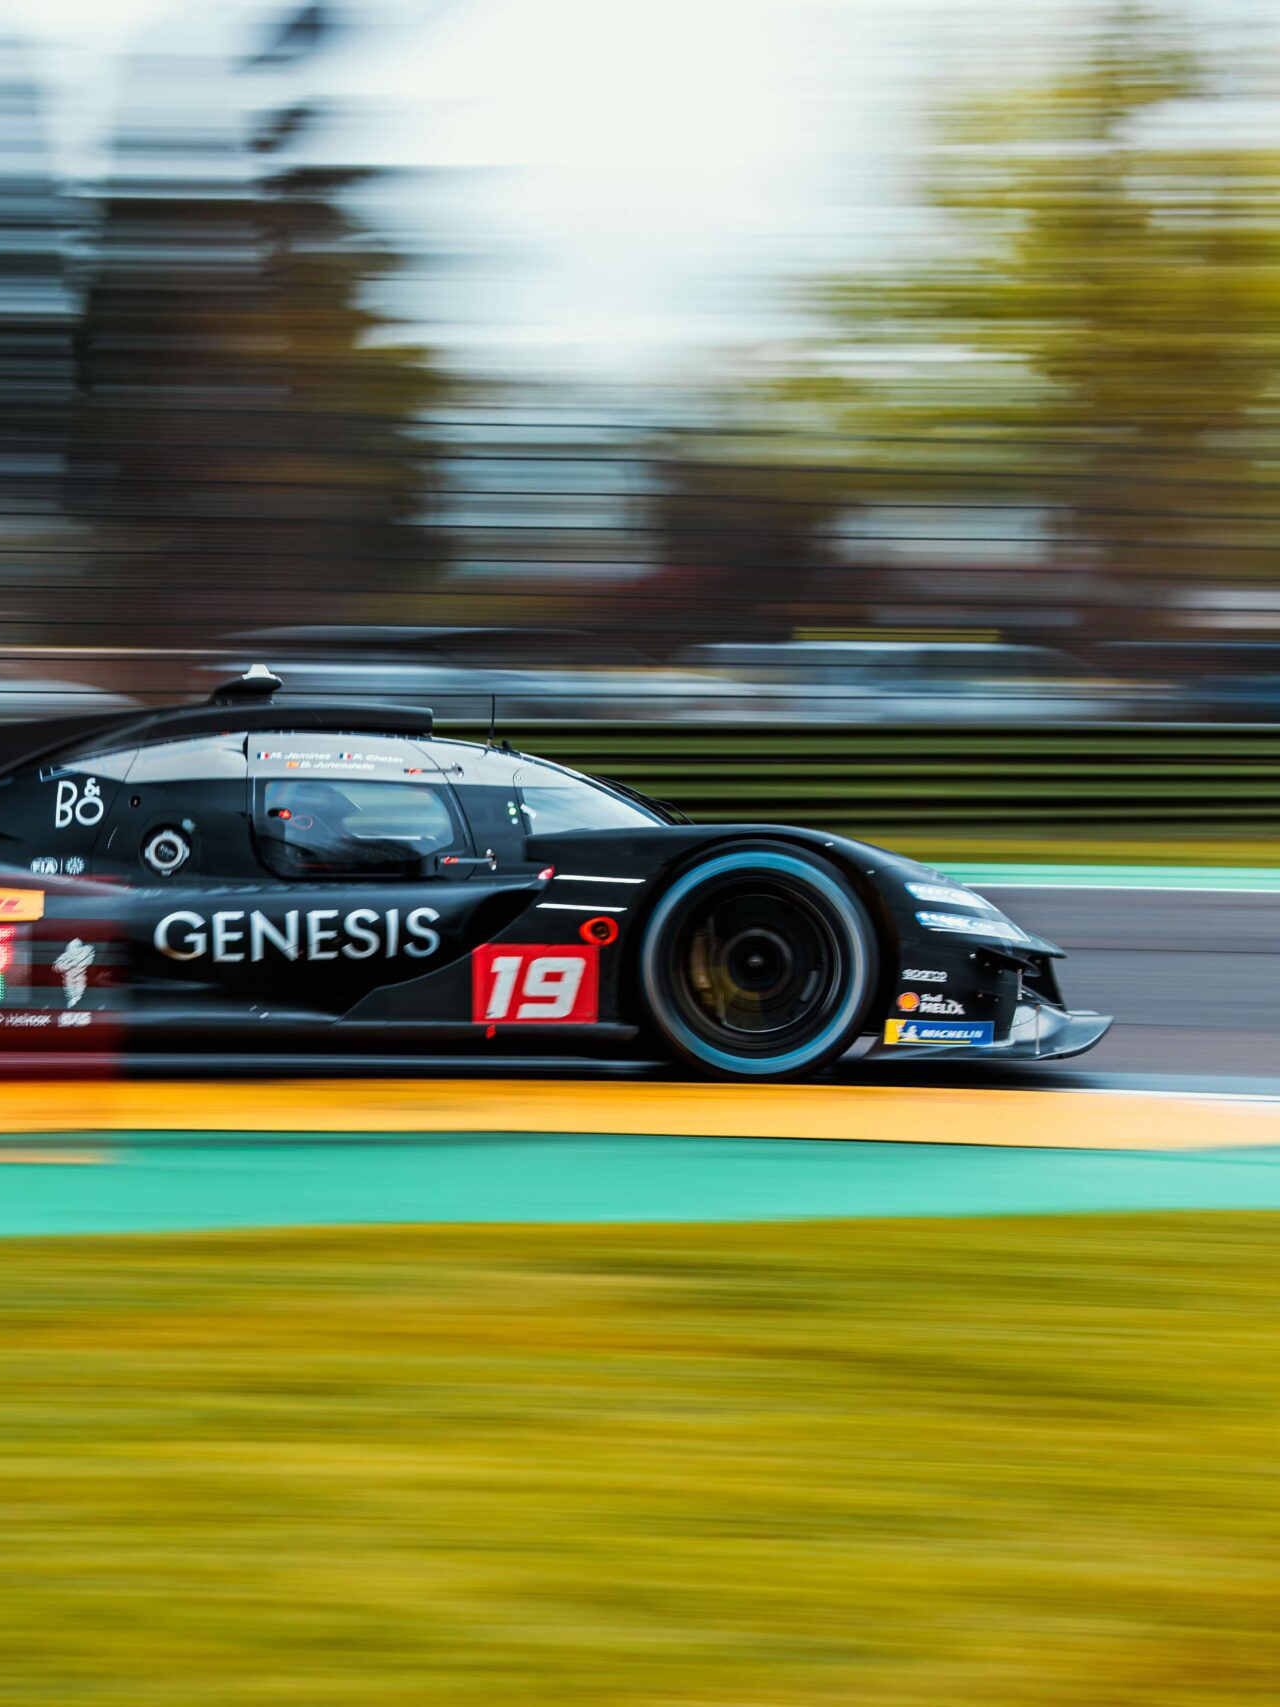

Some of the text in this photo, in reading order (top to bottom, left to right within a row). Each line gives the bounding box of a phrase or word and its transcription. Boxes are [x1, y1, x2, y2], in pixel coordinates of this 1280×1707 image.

[31, 858, 57, 875] FIA
[153, 906, 441, 963] GENESIS
[485, 955, 587, 1019] 19
[919, 1001, 966, 1015] HELIX
[920, 1029, 984, 1039] MICHELIN
